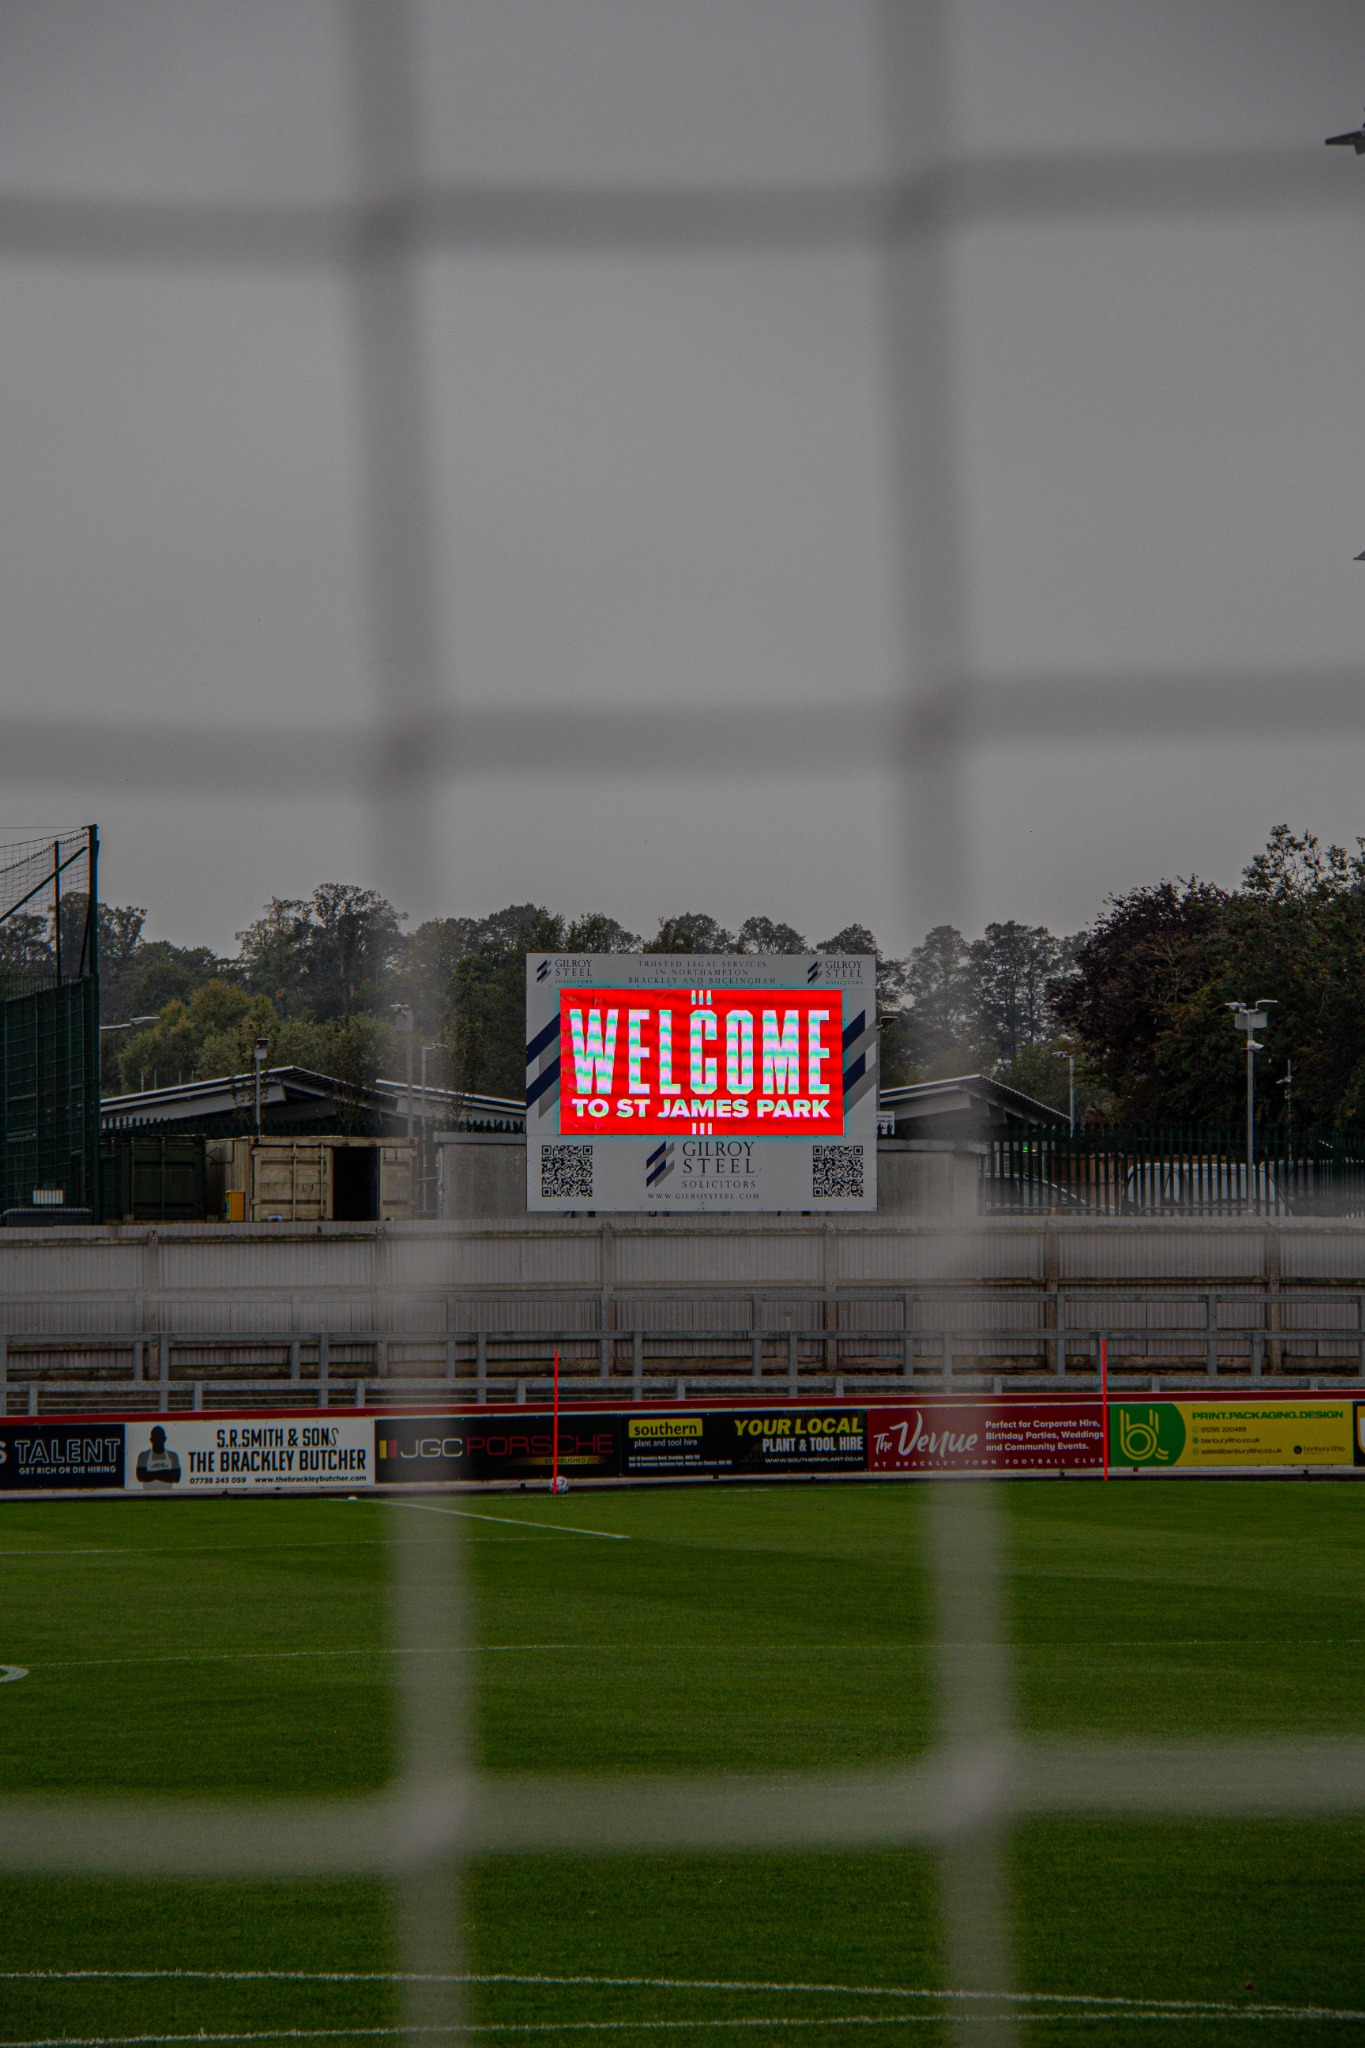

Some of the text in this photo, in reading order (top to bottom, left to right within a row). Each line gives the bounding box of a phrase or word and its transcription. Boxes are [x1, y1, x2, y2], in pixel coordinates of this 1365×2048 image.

[555, 959, 593, 968] GILROY
[639, 960, 682, 968] TRUSTED
[825, 960, 863, 969] GILROY
[555, 968, 593, 977] STEEL
[825, 969, 863, 978] STEEL
[709, 977, 776, 985] BUCKINGHAM
[569, 1008, 830, 1095] WELCOME
[572, 1098, 831, 1118] TO ST JAMES PARK
[682, 1141, 755, 1157] GILROY
[683, 1158, 755, 1174] STEEL
[682, 1180, 756, 1189] SOLICITORS
[634, 1421, 698, 1436] southern
[734, 1417, 864, 1436] YOUR LOCAL
[985, 1419, 1100, 1429] Perfect for Corporate Hire,
[287, 1428, 299, 1447] &
[302, 1427, 340, 1447] SONS
[873, 1410, 978, 1458] The Venue
[985, 1430, 1104, 1441] Birthday Parties, Weddings
[400, 1433, 614, 1459] JGC PORSCHE
[634, 1438, 698, 1449] plant and tool hire
[762, 1436, 864, 1453] PLANT & TOOL HIRE
[985, 1441, 1089, 1452] and Community Events.
[14, 1438, 121, 1464] TALENT
[188, 1449, 366, 1473] THE BRACKLEY BUTCHER
[965, 1459, 997, 1467] TOWN
[19, 1465, 117, 1475] GET RICH OR DIE HIRING
[189, 1477, 214, 1485] 07738
[254, 1475, 367, 1484] www.thebrackleybutcher.com
